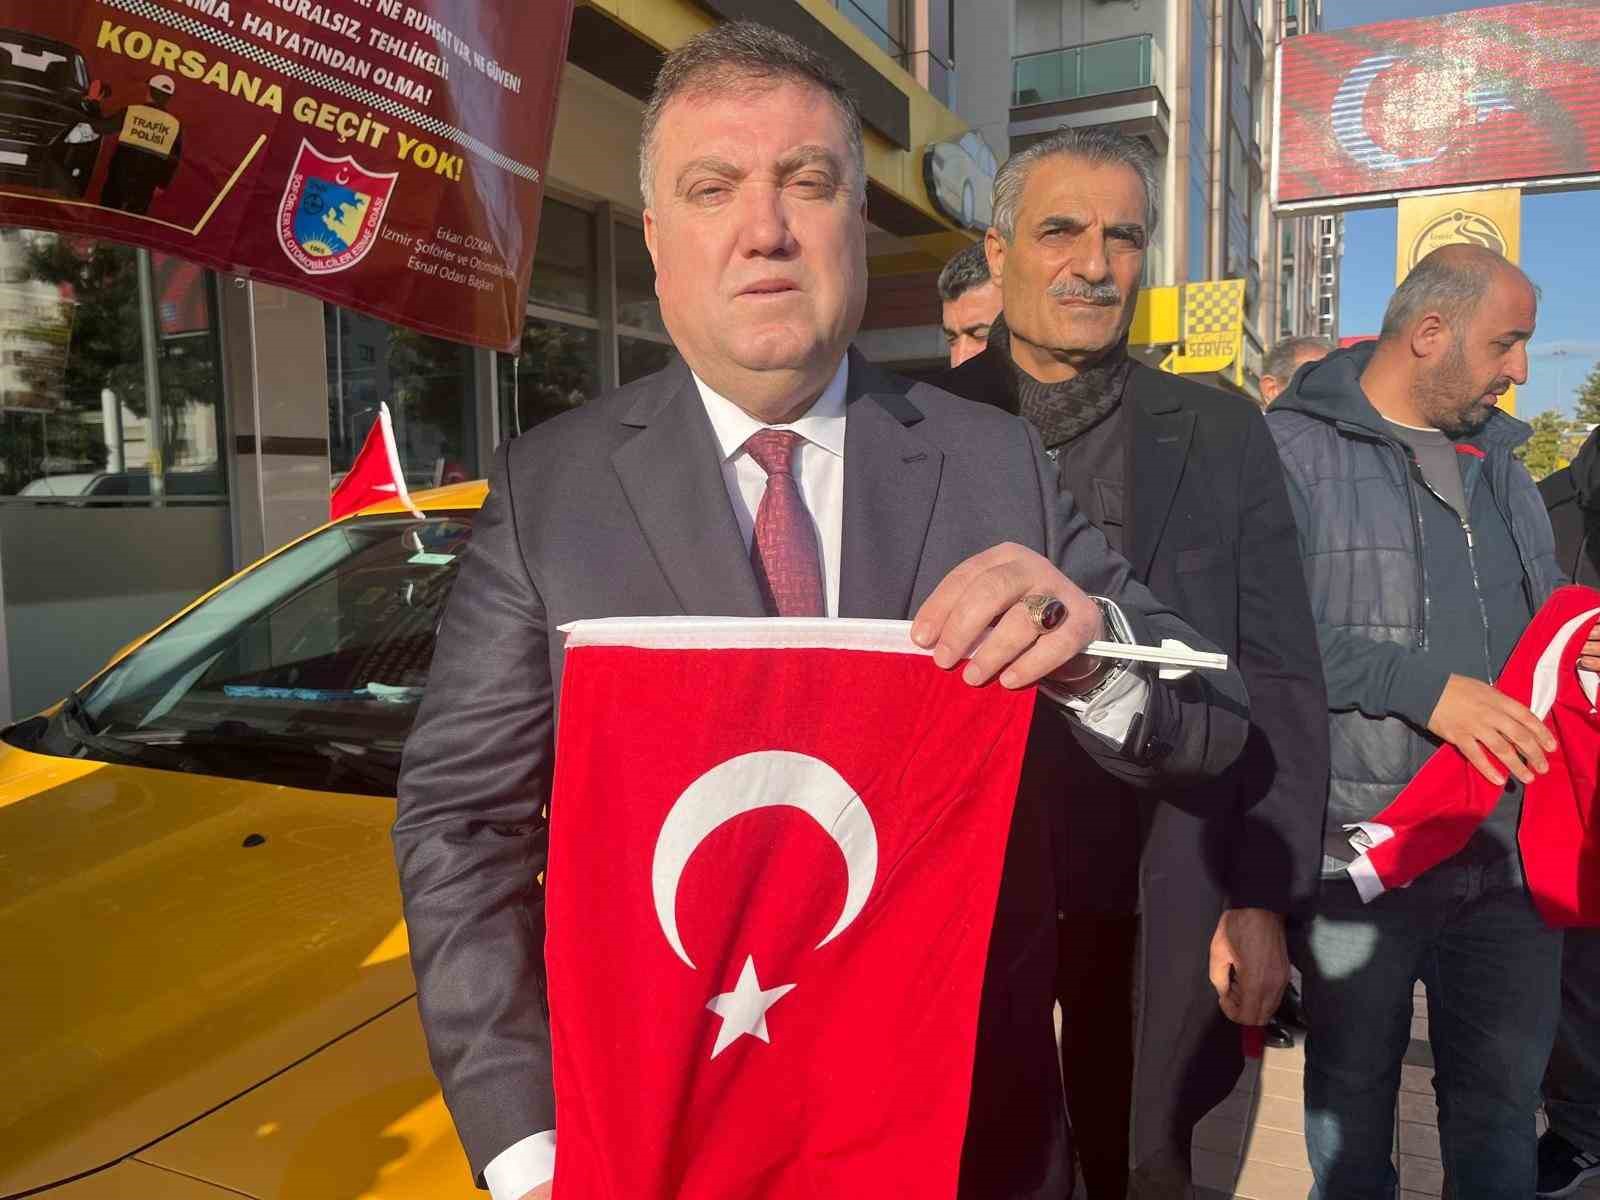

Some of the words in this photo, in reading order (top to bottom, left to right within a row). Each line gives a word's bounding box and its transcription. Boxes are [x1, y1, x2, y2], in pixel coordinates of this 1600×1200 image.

[241, 12, 372, 81] HAYATINDAN
[373, 67, 433, 106] OLMA!
[368, 27, 449, 80] TEHLİKELİ!
[376, 0, 402, 20] NE
[403, 7, 453, 49] RUHSAT
[486, 60, 521, 94] GÜVEN!
[96, 20, 283, 114] KORSANA
[293, 96, 390, 149] GEÇİT
[397, 131, 464, 182] YOK!
[408, 256, 438, 275] Esnaf
[457, 254, 469, 266] ve
